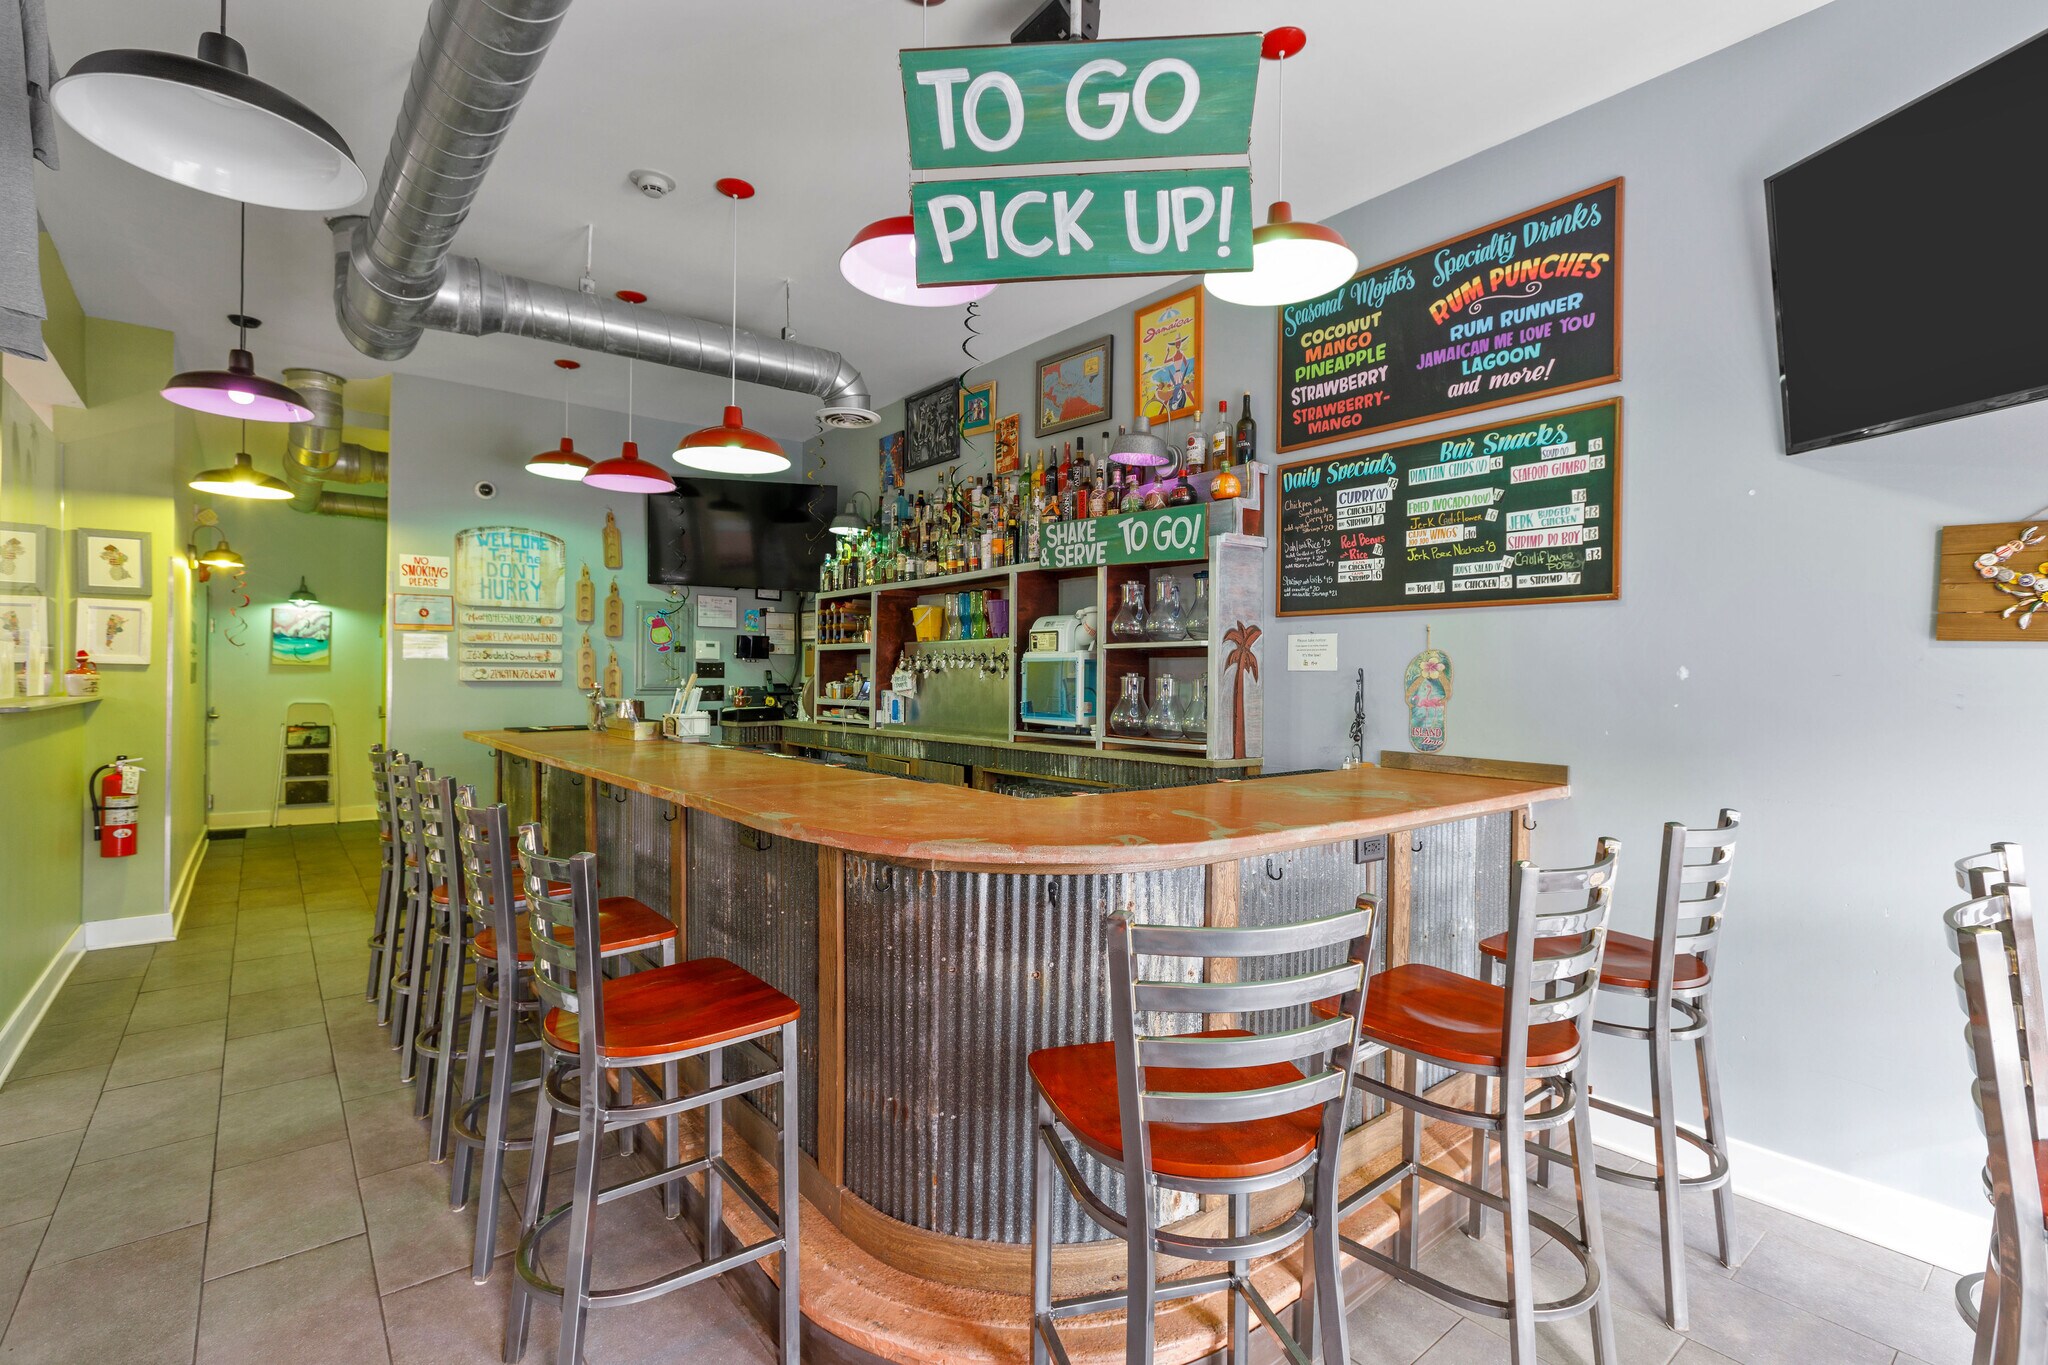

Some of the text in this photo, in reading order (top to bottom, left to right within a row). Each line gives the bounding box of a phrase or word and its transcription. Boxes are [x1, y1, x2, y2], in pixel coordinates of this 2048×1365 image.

[916, 58, 1200, 152] TO GO
[928, 186, 1234, 263] PICK UP!
[1432, 202, 1602, 288] Specialty Drinks
[1429, 253, 1610, 326] RUM PUNCHES
[1285, 265, 1416, 337] Seasonal Mojitos
[1450, 292, 1584, 342] RUM RUNNER
[1143, 317, 1194, 344] Jamaica
[1300, 311, 1382, 348] COCONUT
[1305, 331, 1372, 364] MANGO
[1416, 312, 1596, 370] JAMAICAN ME LOVE YOU
[1295, 342, 1387, 383] PINEAPPLE
[1461, 342, 1542, 376] LAGOON
[1291, 365, 1388, 406] STRAWBERRY
[1447, 358, 1556, 398] and more!
[1292, 391, 1391, 425] STRAWBERRY-
[1308, 413, 1362, 435] MANGO
[1440, 423, 1569, 463] Bar Snacks
[1542, 448, 1559, 459] SOUP
[1283, 453, 1397, 493] Daily Specials
[1410, 465, 1445, 483] PLANTAIN
[1449, 461, 1474, 478] CHIPS
[1476, 459, 1488, 473] (V)
[1512, 464, 1549, 482] SEAFOOD
[1552, 459, 1587, 476] GUMBO
[1339, 488, 1375, 504] CURRY
[1376, 487, 1389, 500] (V)
[1408, 501, 1430, 514] FRIED
[1432, 495, 1471, 511] AVOCADO
[1346, 505, 1373, 516] CHICKEN
[1509, 507, 1571, 530] JERK BURGER
[1541, 515, 1577, 526] CHICKEN
[1346, 517, 1371, 527] SHRIMP
[1429, 526, 1458, 540] WINGS
[476, 532, 550, 551] WELCOME
[1046, 519, 1097, 548] SHAKE
[1118, 517, 1148, 555] TO
[1153, 514, 1202, 555] GO!
[1306, 538, 1322, 549] Rice
[1341, 532, 1386, 549] Red Beans
[1508, 533, 1544, 549] SHRIMP
[1548, 533, 1559, 546] PO
[1561, 530, 1580, 545] BOY
[413, 557, 430, 566] NO
[488, 548, 541, 564] To The
[1040, 541, 1108, 568] & SERVE
[1349, 548, 1369, 560] Rice
[1407, 547, 1430, 561] Jerk
[1452, 543, 1485, 556] Nachos
[401, 563, 449, 579] SMOKING
[1474, 563, 1493, 574] SALAD
[1530, 574, 1563, 585] SHRIMP
[409, 577, 439, 587] PLEASE
[481, 577, 542, 602] HURRY
[1416, 584, 1432, 593] TOFU
[1464, 579, 1497, 589] CHICKEN
[522, 632, 558, 643] UNWIND
[1411, 727, 1443, 738] ISLAND
